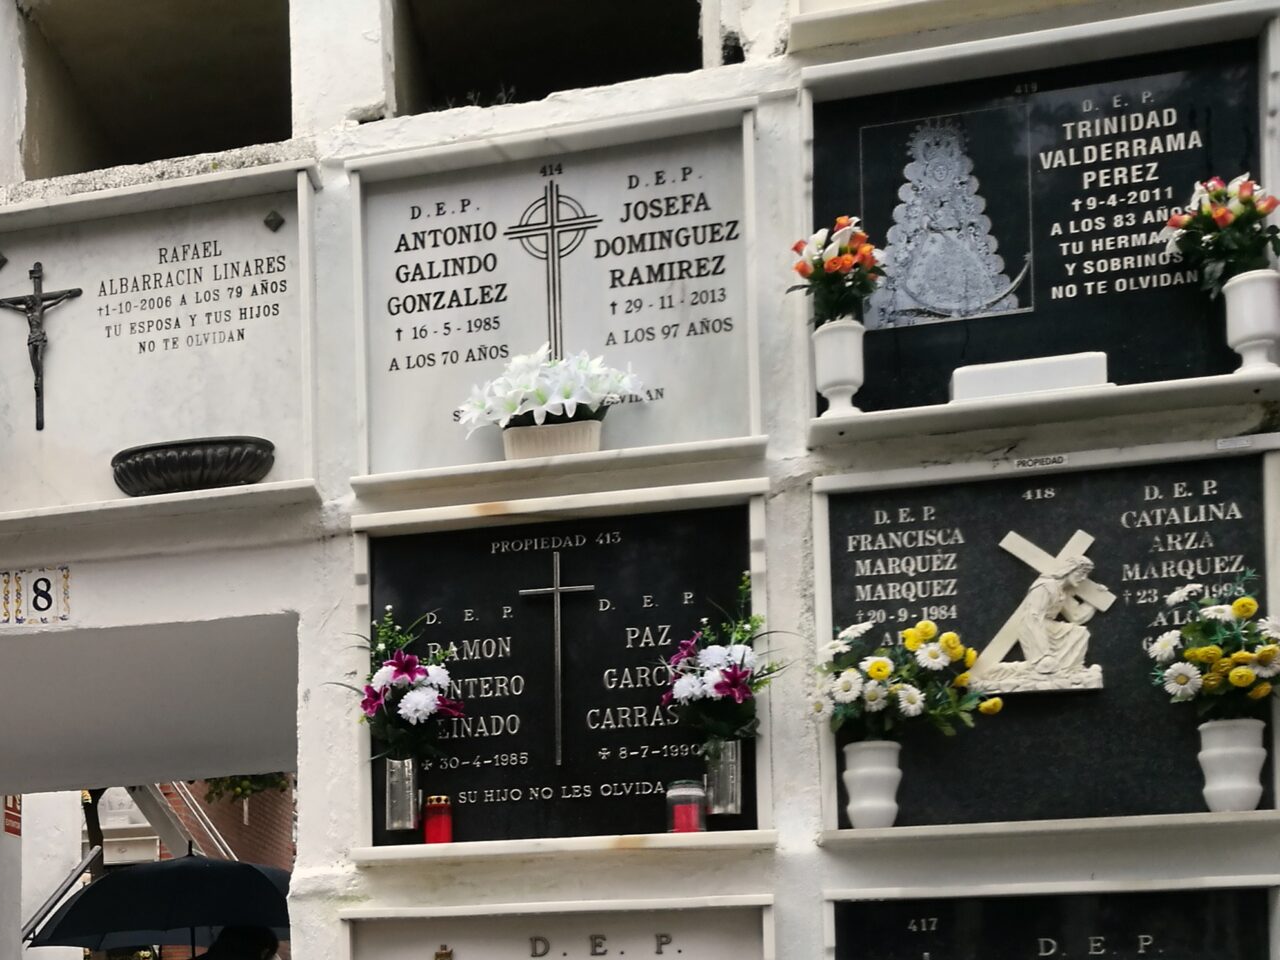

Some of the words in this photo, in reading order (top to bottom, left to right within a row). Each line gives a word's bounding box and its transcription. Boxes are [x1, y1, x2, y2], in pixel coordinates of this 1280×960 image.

[1062, 107, 1177, 141] TRINIDAD
[1039, 130, 1203, 169] VALDERRAMA
[540, 163, 563, 177] 414
[1083, 162, 1159, 189] PEREZ
[620, 192, 711, 223] JOSEFA
[394, 221, 497, 253] ANTONIO
[1050, 223, 1063, 236] A
[1070, 216, 1106, 234] LOS
[1113, 212, 1136, 228] 83
[158, 240, 223, 264] RAFAEL
[594, 220, 740, 259] DOMINGUEZ
[1060, 241, 1084, 256] TU
[98, 267, 204, 297] ALBARRACIN
[213, 255, 287, 281] LINARES
[395, 253, 497, 283] GALINDO
[609, 255, 727, 289] RAMIREZ
[1065, 263, 1076, 277] Y
[1083, 251, 1184, 275] SOBRINOS
[179, 293, 188, 306] A
[195, 289, 221, 304] LOS
[227, 285, 243, 300] 79
[251, 279, 288, 297] AÑOS
[690, 287, 727, 306] 2013
[1051, 284, 1077, 300] NO
[1084, 281, 1108, 296] TE
[1115, 269, 1199, 293] OLVIDAN
[387, 283, 508, 316] GONZALEZ
[105, 323, 121, 338] TU
[129, 316, 181, 335] ESPOSA
[189, 314, 197, 327] Y
[205, 310, 232, 325] TUS
[239, 303, 280, 321] HIJOS
[467, 316, 501, 334] 1985
[605, 332, 618, 346] A
[624, 327, 656, 344] LOS
[661, 324, 680, 339] 97
[686, 318, 734, 337] AÑOS
[138, 340, 156, 354] NO
[163, 337, 179, 351] TE
[186, 328, 246, 348] OLVIDAN
[388, 358, 400, 371] A
[406, 353, 437, 370] LOS
[441, 350, 459, 365] 70
[465, 344, 509, 363] AÑOS
[1022, 488, 1056, 500] 418
[1120, 502, 1243, 528] CATALINA
[491, 535, 586, 554] PROPIEDAD
[595, 532, 622, 545] 413
[847, 527, 965, 552] FRANCISCA
[1149, 531, 1214, 552] ARZA
[855, 553, 958, 577] MARQUEZ
[1121, 555, 1245, 581] MARQUEZ
[32, 577, 53, 612] 8
[855, 578, 958, 602] MARQUEZ
[921, 605, 958, 621] 1984
[625, 625, 672, 648] PAZ
[439, 752, 529, 770] 30-4-1985
[458, 790, 478, 804] SU
[484, 789, 522, 803] HIJO
[529, 787, 553, 801] NO
[561, 784, 592, 799] LES
[908, 918, 938, 932] 417
